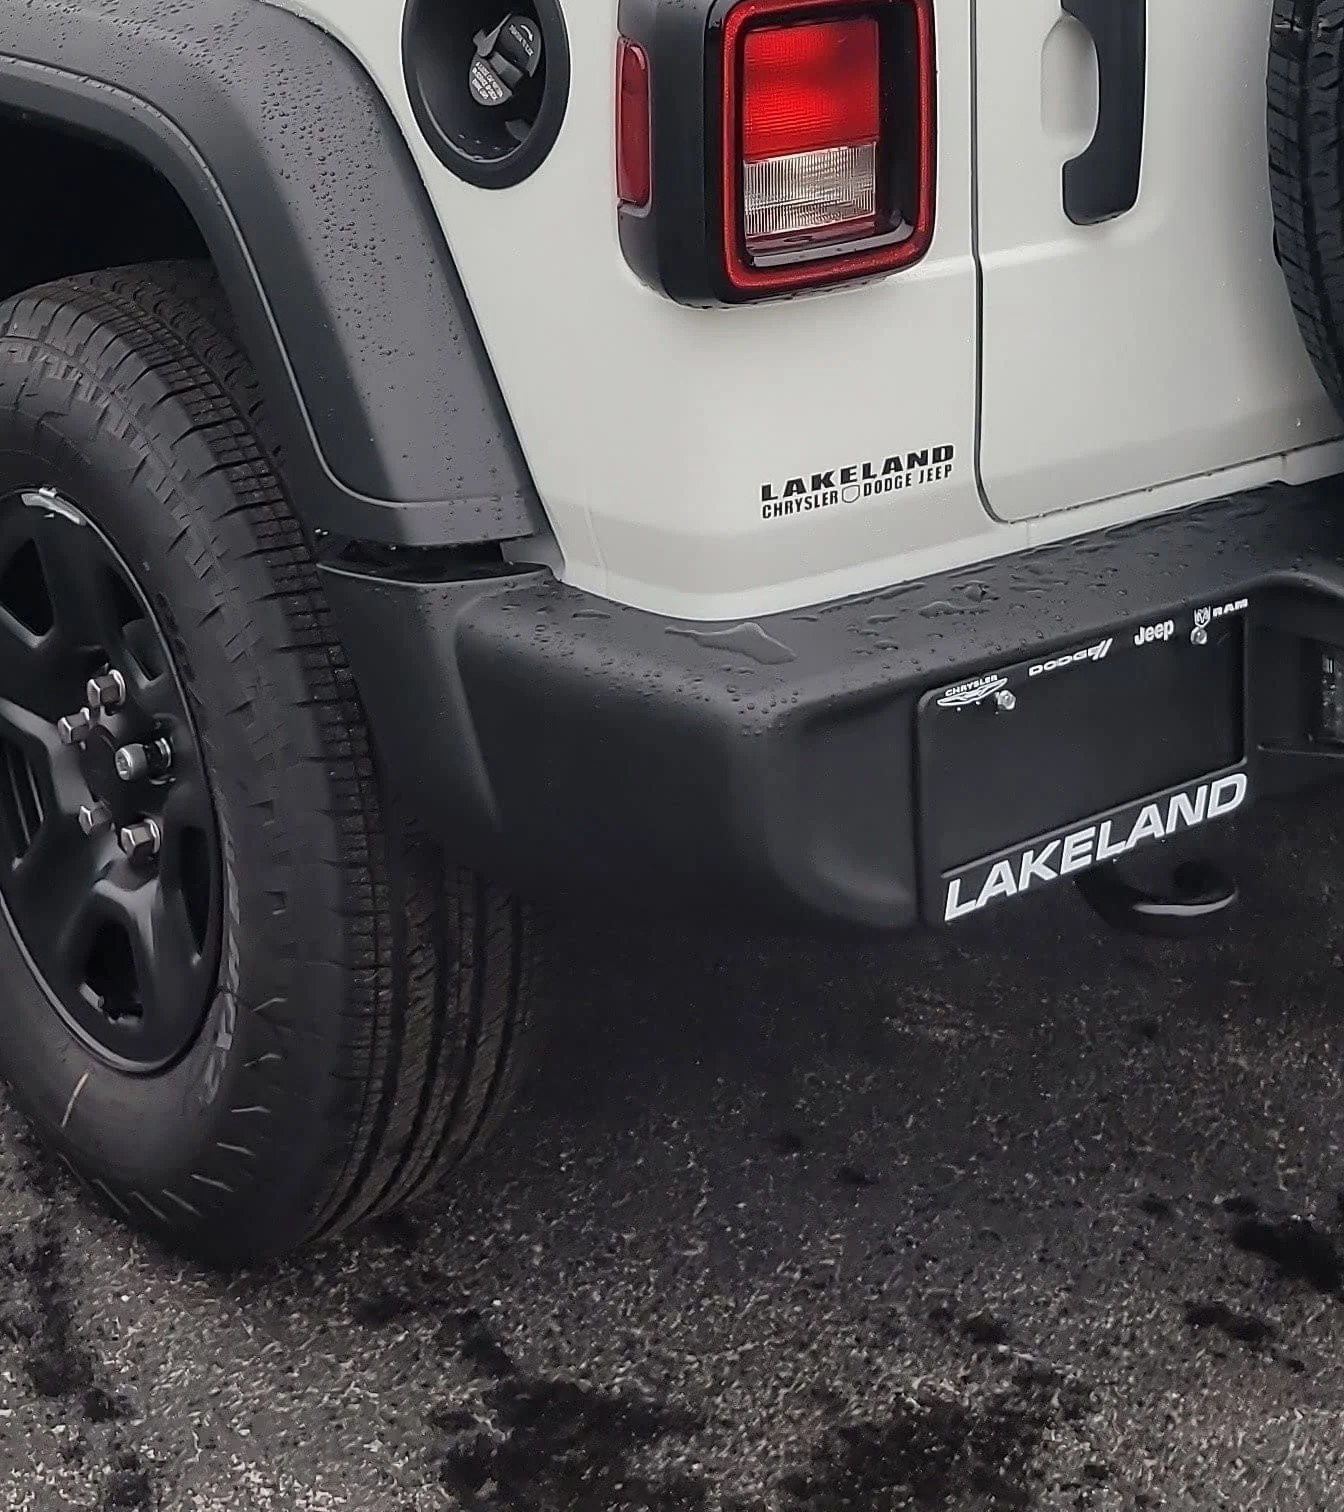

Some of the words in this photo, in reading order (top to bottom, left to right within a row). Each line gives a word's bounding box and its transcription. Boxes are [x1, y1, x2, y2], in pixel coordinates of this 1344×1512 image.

[760, 444, 955, 502] LAKELAND
[762, 491, 839, 519] CHRYSLER
[863, 472, 912, 497] DODGE
[918, 464, 954, 486] JEEP
[944, 674, 998, 697] CHRYSLER
[1028, 643, 1103, 677] DODGE
[1133, 619, 1174, 646] Jeep
[1212, 598, 1249, 618] RAM
[944, 772, 1248, 922] LAKELAND
